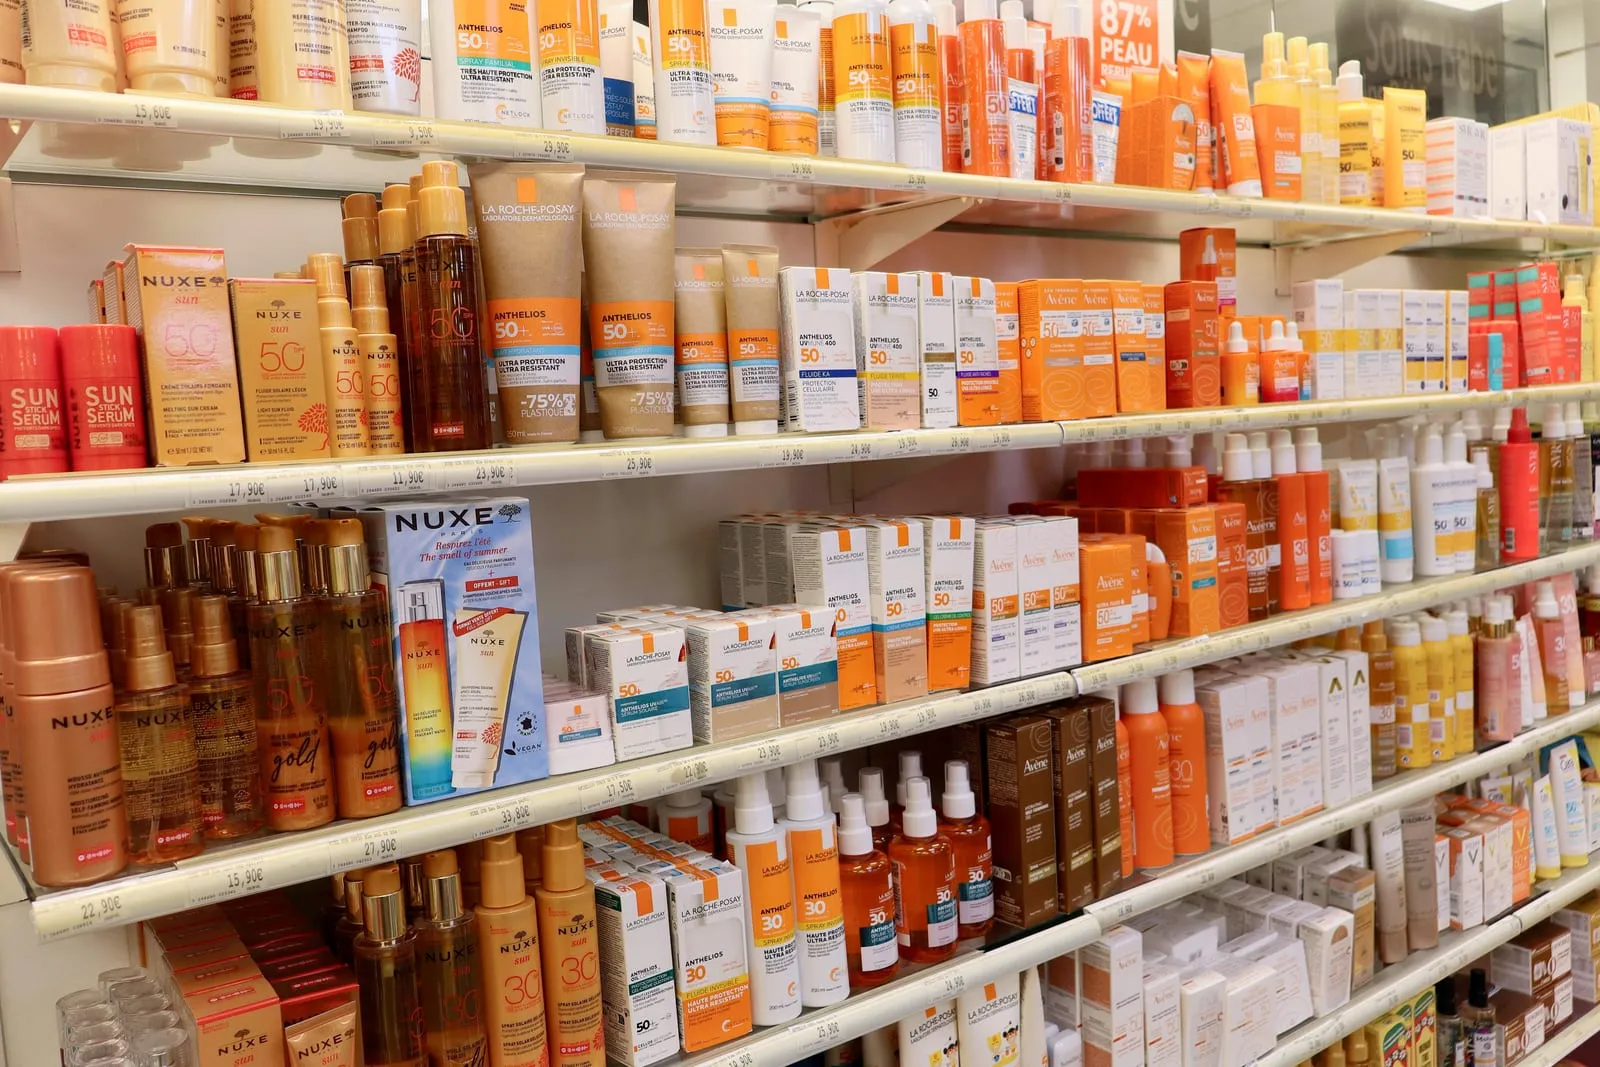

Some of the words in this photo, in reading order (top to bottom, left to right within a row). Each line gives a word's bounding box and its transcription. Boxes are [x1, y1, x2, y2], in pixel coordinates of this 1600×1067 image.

[1100, 0, 1152, 37] 87%
[457, 24, 503, 33] ANTHELIOS
[668, 29, 706, 37] ANTHELIOS
[1100, 37, 1153, 66] PEAU
[459, 57, 484, 66] SPRAY
[485, 59, 516, 67] FAMILIAL
[499, 70, 533, 80] PROTECTION
[556, 66, 595, 74] PROTECTION
[988, 95, 1007, 114] 50
[1009, 90, 1037, 116] OFFERT
[135, 104, 171, 120] 15,60€
[1092, 101, 1121, 126] OFFERT
[605, 127, 634, 136] OFFERT
[1234, 116, 1252, 132] 50
[408, 127, 434, 139] 9,50€
[1275, 126, 1296, 142] Avène
[544, 140, 570, 155] 29,90€
[1402, 149, 1415, 160] 50
[481, 204, 496, 214] LA
[498, 203, 576, 216] ROCHE-POSAY
[589, 213, 603, 222] LA
[605, 212, 670, 222] ROCHE-POSAY
[521, 214, 575, 222] DERMATOLOGIQUE
[143, 275, 206, 288] NUXE
[175, 294, 200, 306] sun
[796, 290, 805, 298] LA
[806, 290, 849, 299] ROCHE-POSAY
[878, 296, 916, 304] ROCHE-POSAY
[1045, 293, 1077, 306] Avène
[1083, 293, 1109, 305] Avène
[1117, 292, 1141, 305] Avène
[256, 310, 302, 320] NUXE
[494, 310, 547, 321] ANTHELIOS
[602, 312, 652, 323] ANTHELIOS
[270, 325, 289, 334] sun
[495, 321, 530, 339] 50+
[603, 323, 637, 340] 50+
[260, 342, 306, 373] 50
[498, 358, 519, 367] ULTRA
[519, 357, 566, 367] PROTECTION
[801, 348, 827, 362] 50+
[870, 351, 893, 364] 50+
[499, 365, 519, 373] ULTRA
[519, 364, 560, 373] RESISTANT
[336, 371, 363, 394] 50
[370, 374, 399, 397] 50
[10, 387, 59, 409] SUN
[85, 385, 134, 407] SUN
[631, 391, 667, 406] -75%
[928, 388, 938, 397] 50
[98, 403, 120, 411] STICK
[520, 393, 563, 409] -75%
[12, 410, 60, 426] SERUM
[87, 407, 135, 424] SERUM
[521, 408, 564, 417] PLASTIQUE
[782, 449, 804, 461] 19,90€
[627, 457, 652, 470] 25,90€
[392, 471, 424, 485] 11,90€
[476, 466, 505, 480] 23,90€
[229, 482, 265, 497] 17,90€
[303, 477, 338, 492] 17,90€
[395, 507, 495, 533] NUXE
[1247, 519, 1276, 533] Avène
[1434, 519, 1447, 531] 50
[435, 537, 471, 551] Respirez
[419, 552, 436, 563] The
[438, 550, 462, 562] smell
[464, 549, 472, 560] of
[474, 547, 508, 556] summer
[834, 552, 865, 560] ROCHE-POSAY
[1249, 550, 1265, 567] 30
[1096, 576, 1124, 589] Avène
[828, 593, 858, 602] ANTHELIOS
[885, 587, 914, 596] ANTHELIOS
[992, 598, 1004, 613] 50
[1560, 596, 1575, 613] 30
[470, 637, 505, 646] NUXE
[407, 649, 441, 660] NUXE
[626, 656, 634, 664] LA
[635, 650, 672, 662] ROCHE-POSAY
[416, 662, 433, 670] sun
[781, 657, 801, 670] 50+
[715, 670, 735, 684] 50+
[619, 683, 642, 698] 50+
[52, 705, 114, 730] NUXE
[137, 708, 188, 728] NUXE
[1379, 706, 1392, 720] 30
[516, 743, 542, 753] VEGAN
[818, 733, 840, 748] 23,90€
[270, 737, 322, 782] gold
[757, 745, 781, 759] 23,90€
[1066, 748, 1087, 762] Avène
[684, 763, 708, 779] 22,90€
[1024, 757, 1049, 774] Avène
[1170, 759, 1193, 781] 30
[606, 780, 632, 797] 17,50€
[501, 805, 530, 824] 33,80€
[364, 838, 397, 857] 27,90€
[227, 868, 264, 889] 15,90€
[804, 888, 838, 900] ANTHELIOS
[81, 896, 122, 919] 22,90€
[681, 909, 691, 917] LA
[692, 895, 742, 914] ROCHE-POSAY
[805, 900, 826, 915] 30
[633, 911, 665, 926] ROCHE-POSAY
[761, 915, 783, 931] 30
[870, 912, 885, 926] 30
[557, 920, 594, 935] NUXE
[806, 931, 823, 939] HAUTE
[500, 936, 537, 954] NUXE
[571, 937, 587, 948] sun
[685, 951, 724, 968] ANTHELIOS
[561, 952, 598, 985] 30
[630, 964, 658, 977] ANTHELIOS
[686, 965, 706, 983] 30
[504, 969, 541, 1005] 30
[686, 986, 706, 999] FLUIDE
[707, 977, 740, 993] INVISIBLE
[687, 997, 709, 1008] HAUTE
[710, 984, 749, 1001] PROTECTION
[687, 1003, 709, 1014] ULTRA
[710, 992, 744, 1008] RESISTANT
[968, 1010, 979, 1021] LA
[981, 992, 1018, 1014] ROCHE-POSAY
[817, 1022, 840, 1039] 25,90€
[218, 1035, 268, 1057] NUXE
[298, 1033, 343, 1060] NUXE
